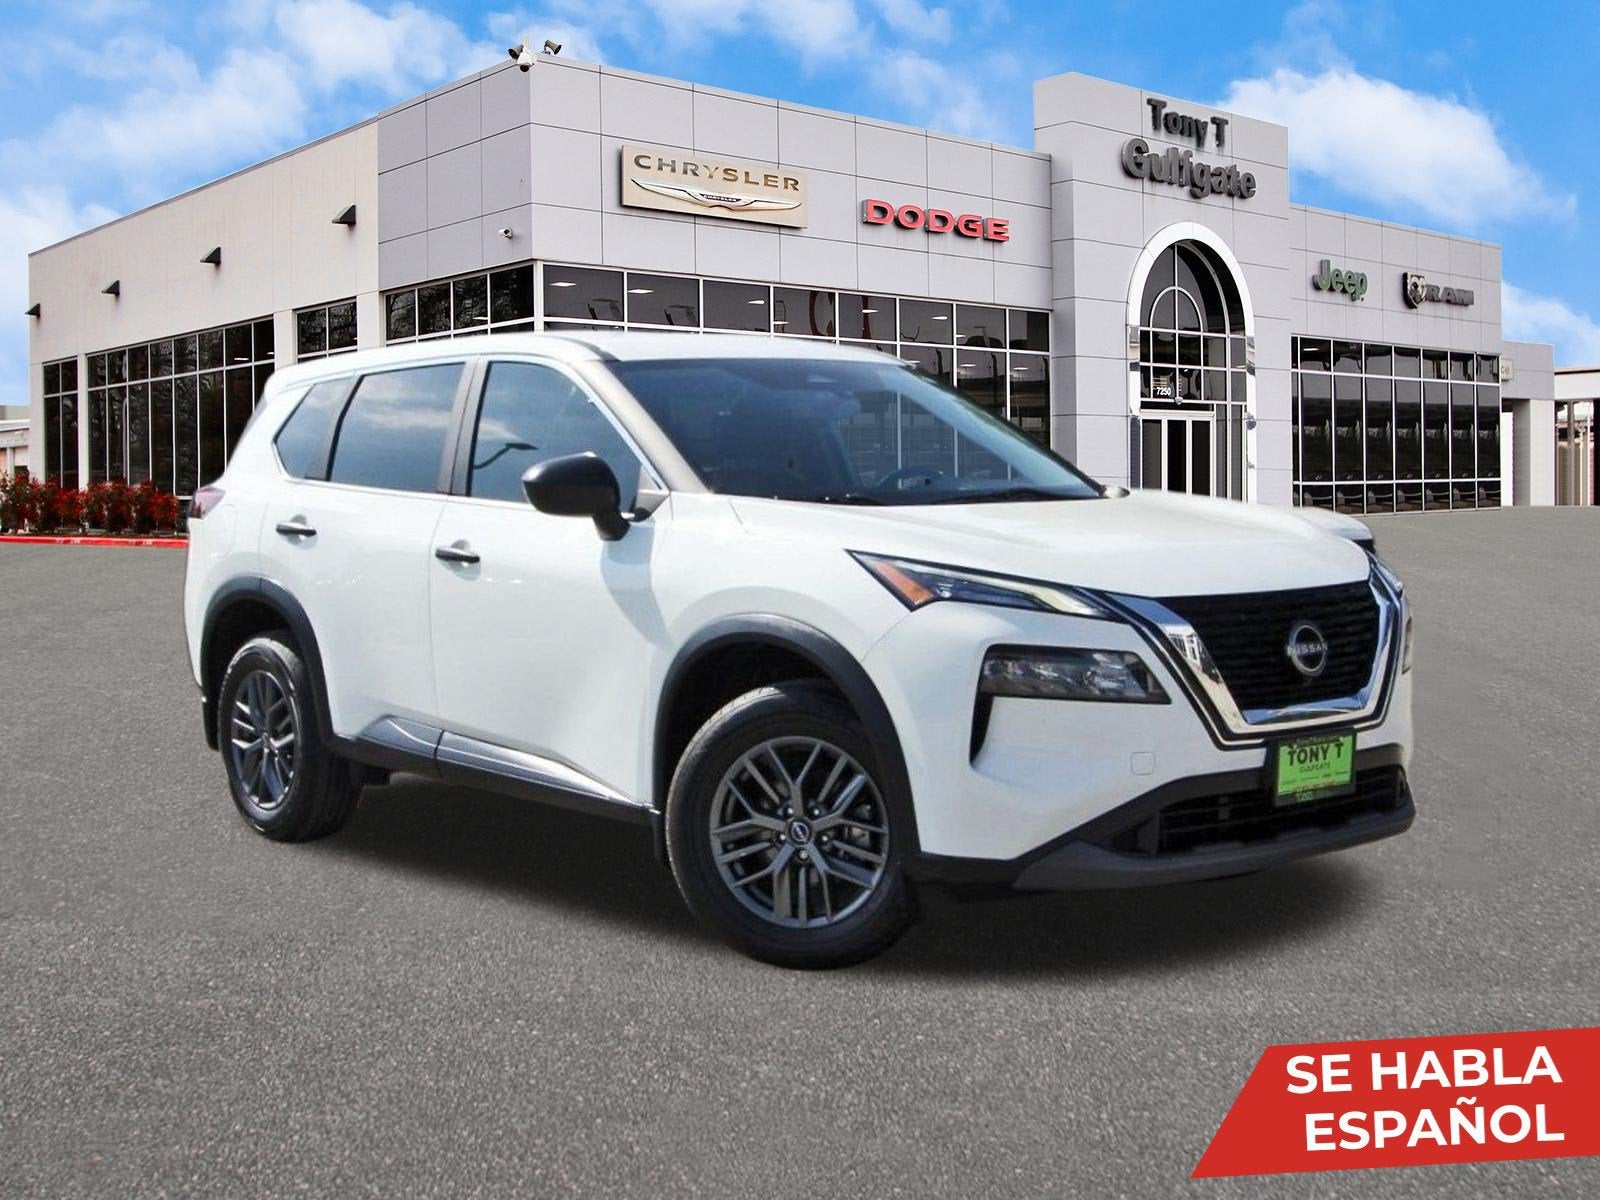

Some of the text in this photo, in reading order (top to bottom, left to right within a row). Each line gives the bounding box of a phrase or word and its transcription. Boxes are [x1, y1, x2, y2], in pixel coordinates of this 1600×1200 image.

[1147, 97, 1229, 148] Tony T
[633, 153, 801, 193] CHRYSLER
[1121, 137, 1257, 199] Gulfgate
[862, 197, 1011, 243] DODGE
[1312, 259, 1368, 301] Jeep
[1424, 283, 1475, 306] RAM
[1156, 386, 1172, 396] 7250
[1287, 744, 1330, 767] TONY
[1334, 741, 1345, 759] T
